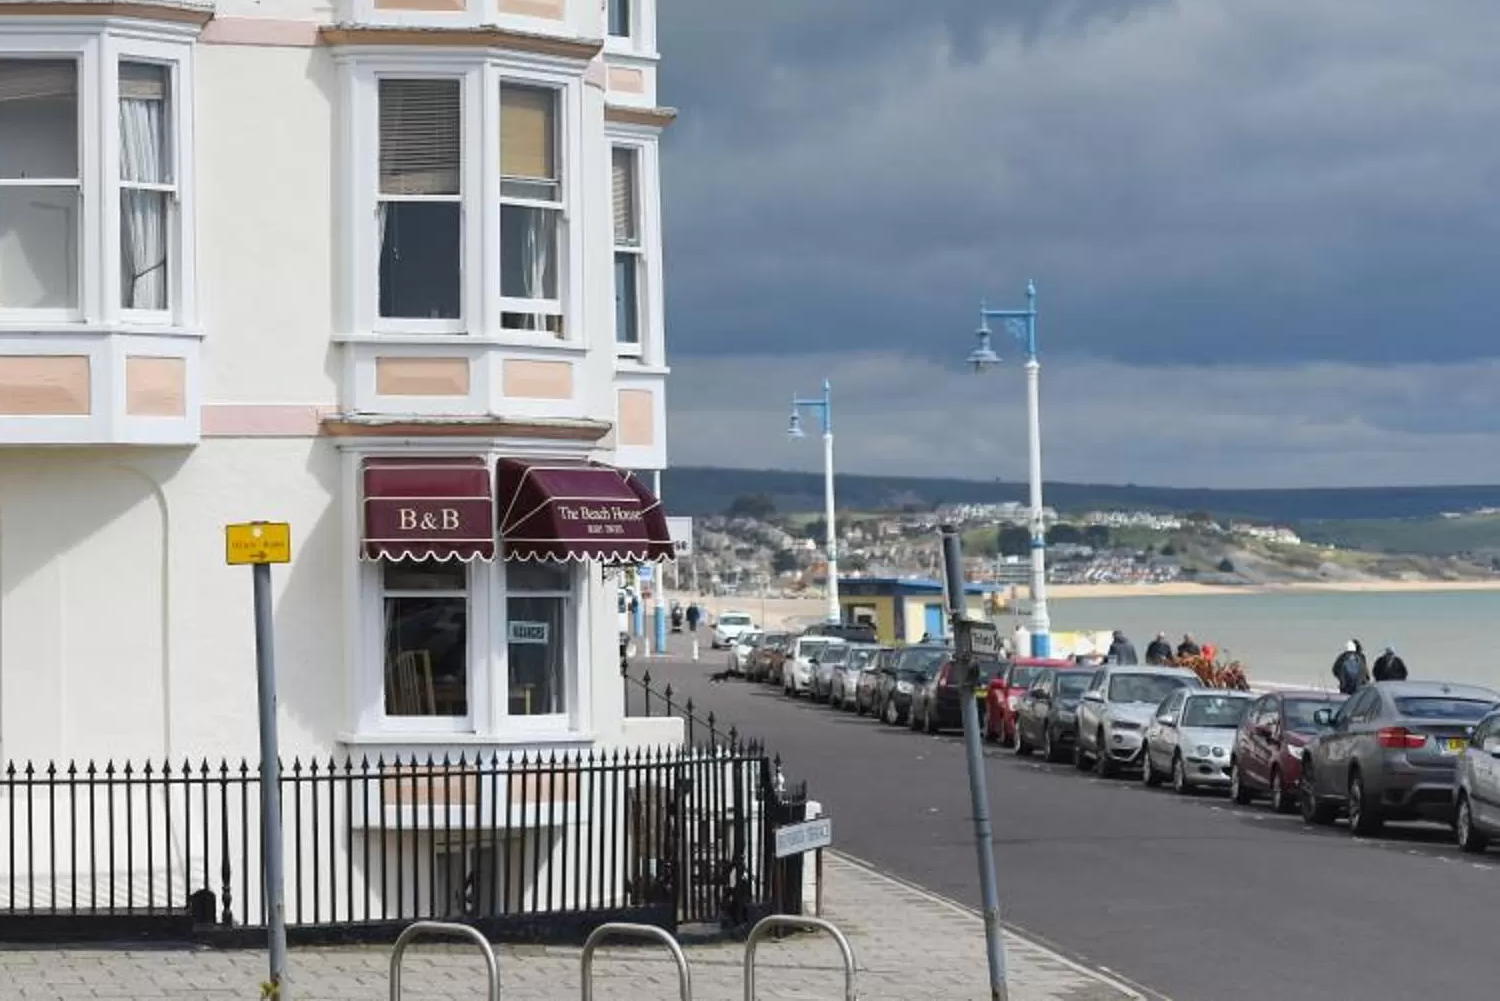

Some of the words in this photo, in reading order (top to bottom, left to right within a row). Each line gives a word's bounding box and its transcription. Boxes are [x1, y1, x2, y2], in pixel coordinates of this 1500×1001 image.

[400, 509, 460, 530] B&B
[558, 506, 578, 520] The
[580, 506, 611, 520] Beach
[611, 506, 642, 520] House
